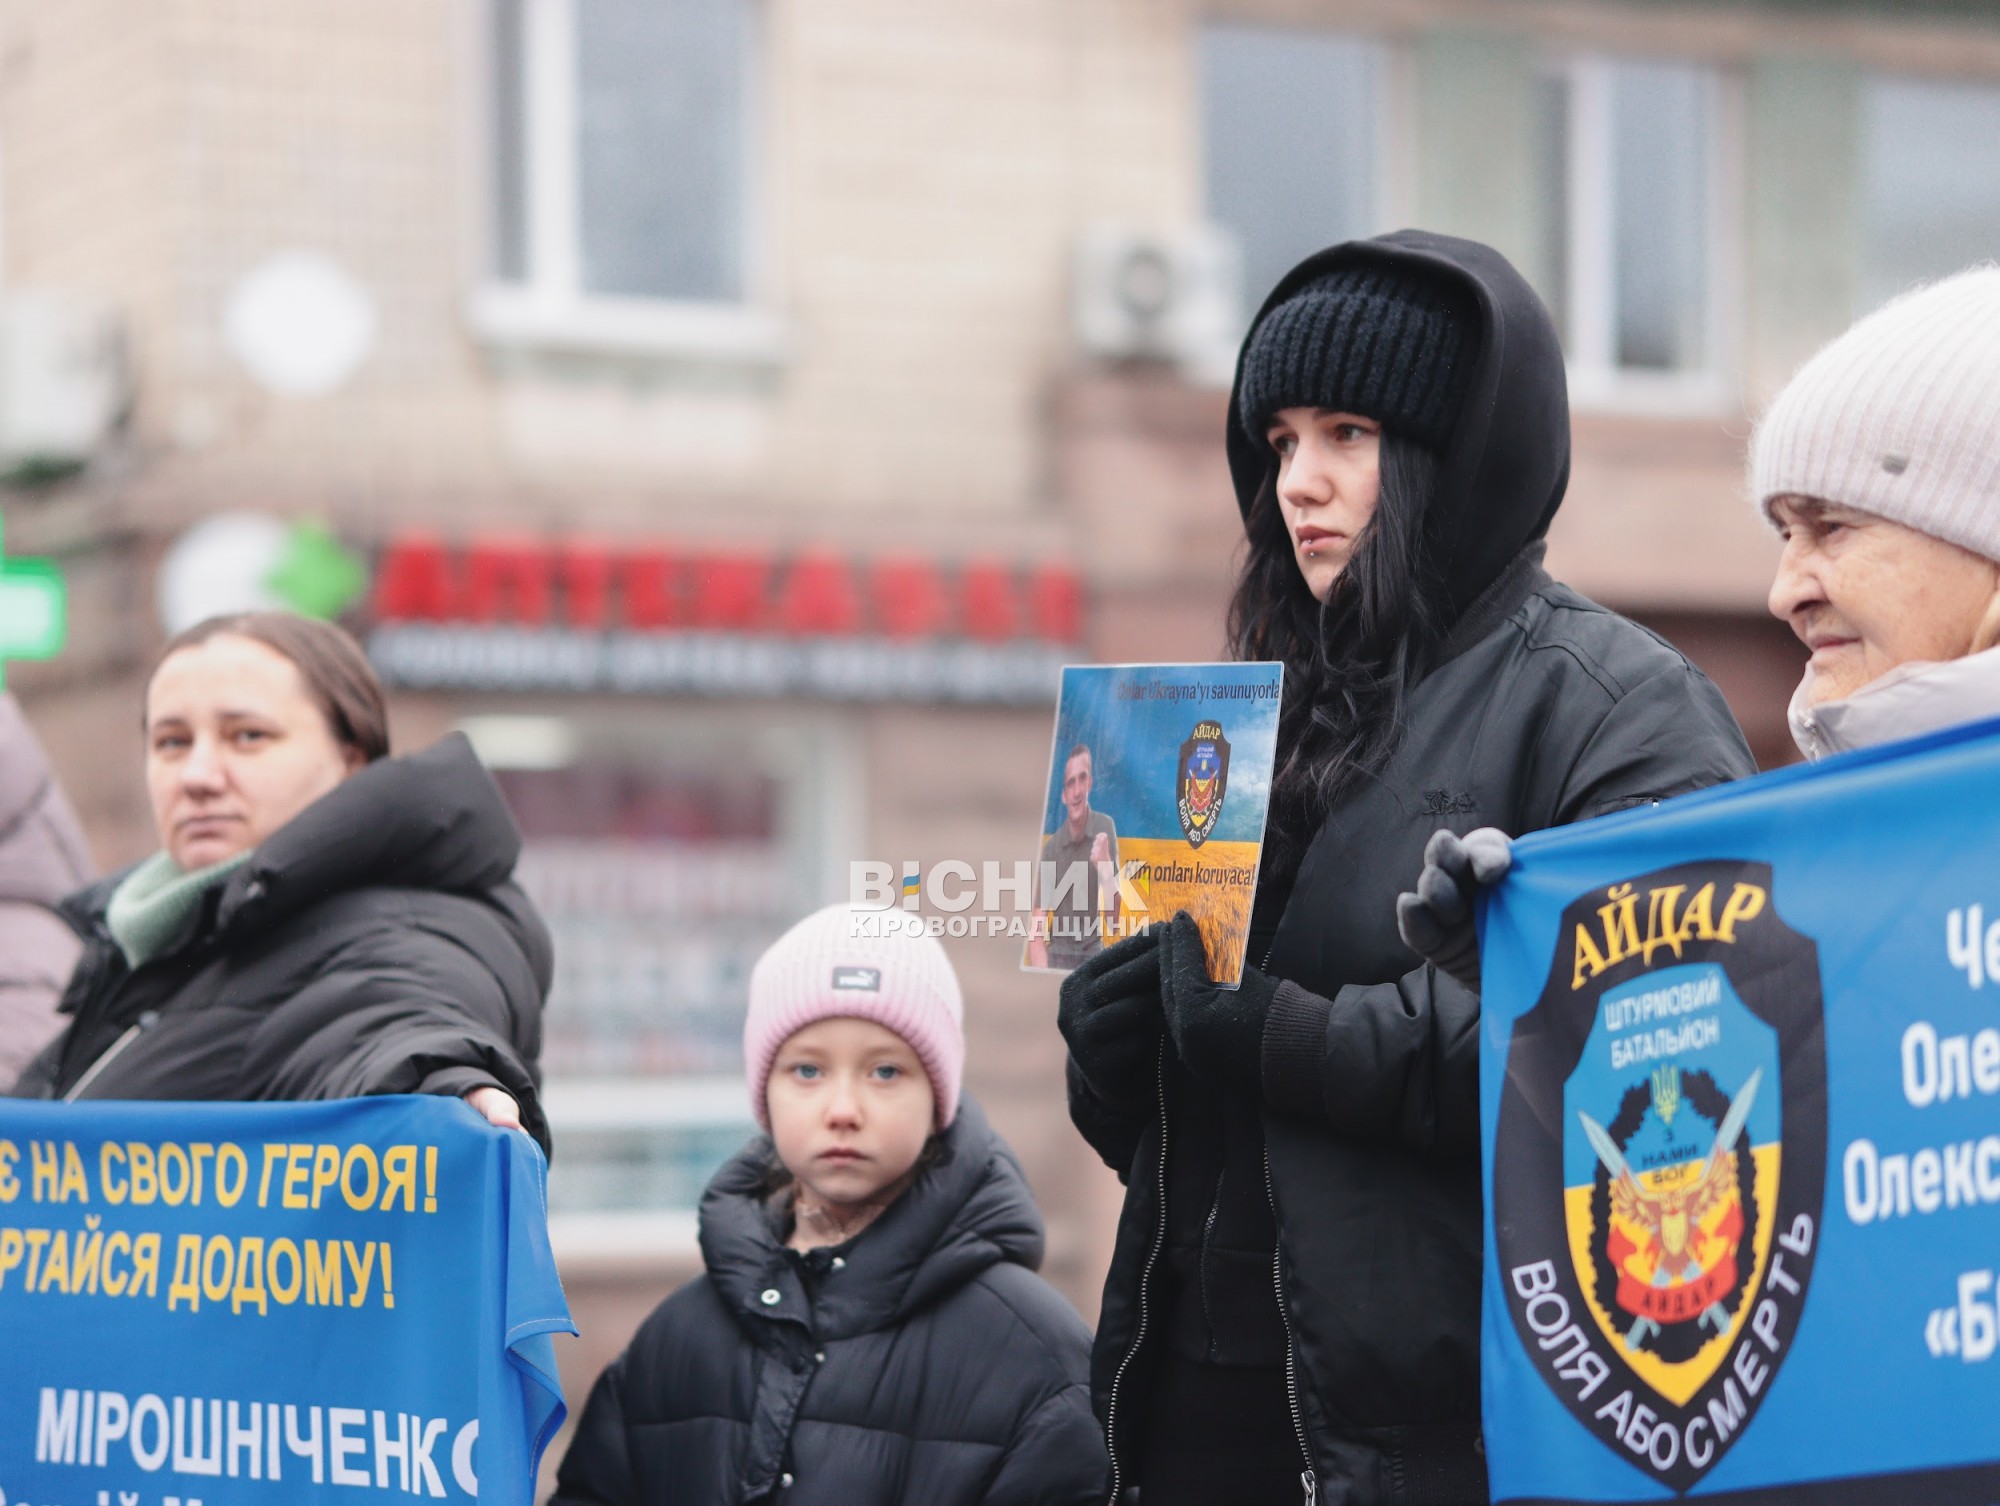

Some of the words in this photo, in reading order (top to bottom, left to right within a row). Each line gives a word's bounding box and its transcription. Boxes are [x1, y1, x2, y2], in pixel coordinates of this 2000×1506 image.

[1192, 723, 1221, 740] АЙДАР
[1178, 798, 1191, 829] ВОЛЯ
[1188, 828, 1201, 842] АБО
[1154, 860, 1193, 884] onları
[1571, 881, 1767, 991] АЙДАР
[1604, 971, 1721, 1032] ШТУРМОВИЙ
[1610, 1016, 1719, 1070] БАТАЛЬЙОН
[30, 1140, 90, 1204] НА
[100, 1141, 248, 1208] СВОГО
[258, 1143, 439, 1213] ГЕРОЯ!
[0, 1214, 161, 1298] РТАЙСЯ
[168, 1234, 395, 1316] ДОДОМУ!
[1511, 1259, 1611, 1401] ВОЛЯ
[1594, 1389, 1680, 1471] АБО
[1684, 1213, 1814, 1469] СМЕРТЬ
